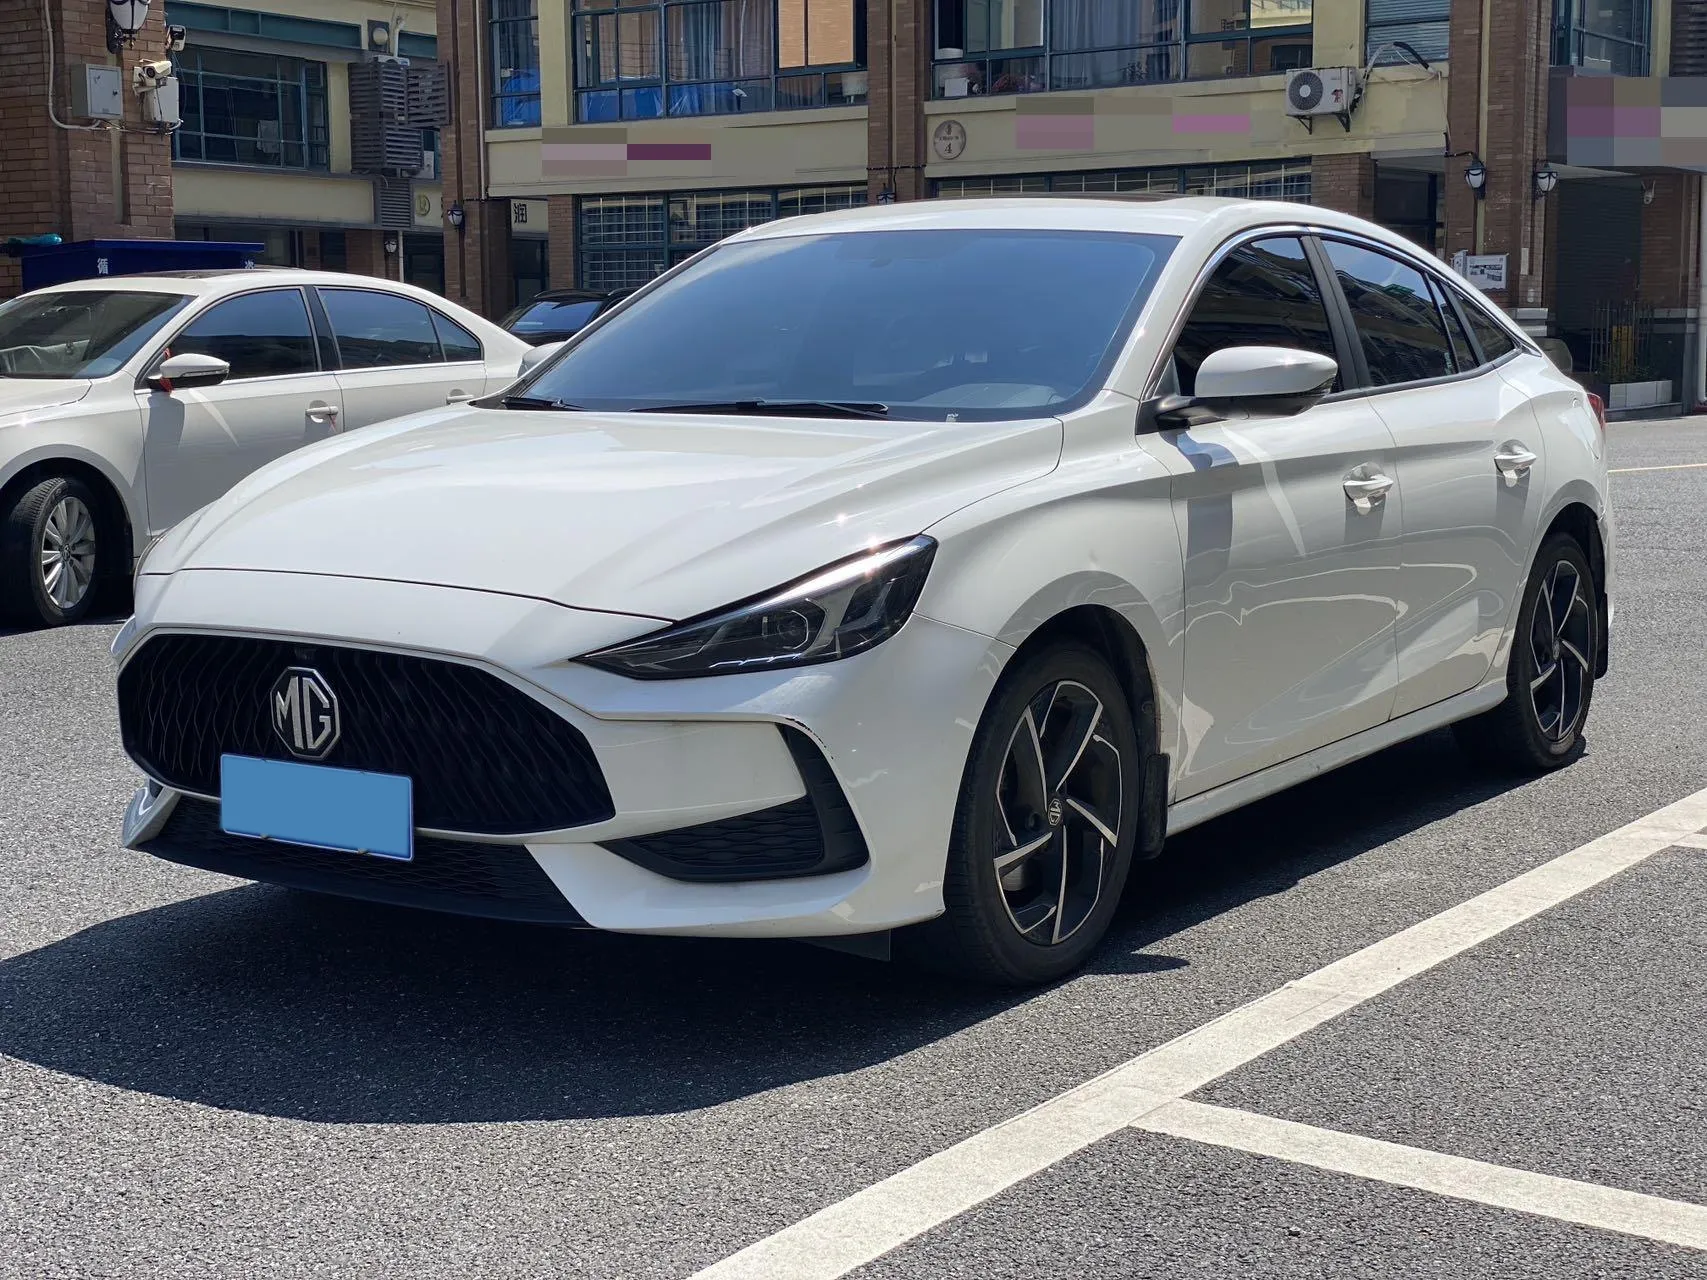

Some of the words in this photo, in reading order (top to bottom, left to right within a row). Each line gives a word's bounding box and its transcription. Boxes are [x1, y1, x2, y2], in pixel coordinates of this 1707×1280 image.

[513, 202, 528, 223] 润
[97, 257, 109, 275] 循
[275, 675, 331, 749] MG
[1050, 801, 1061, 823] MG
